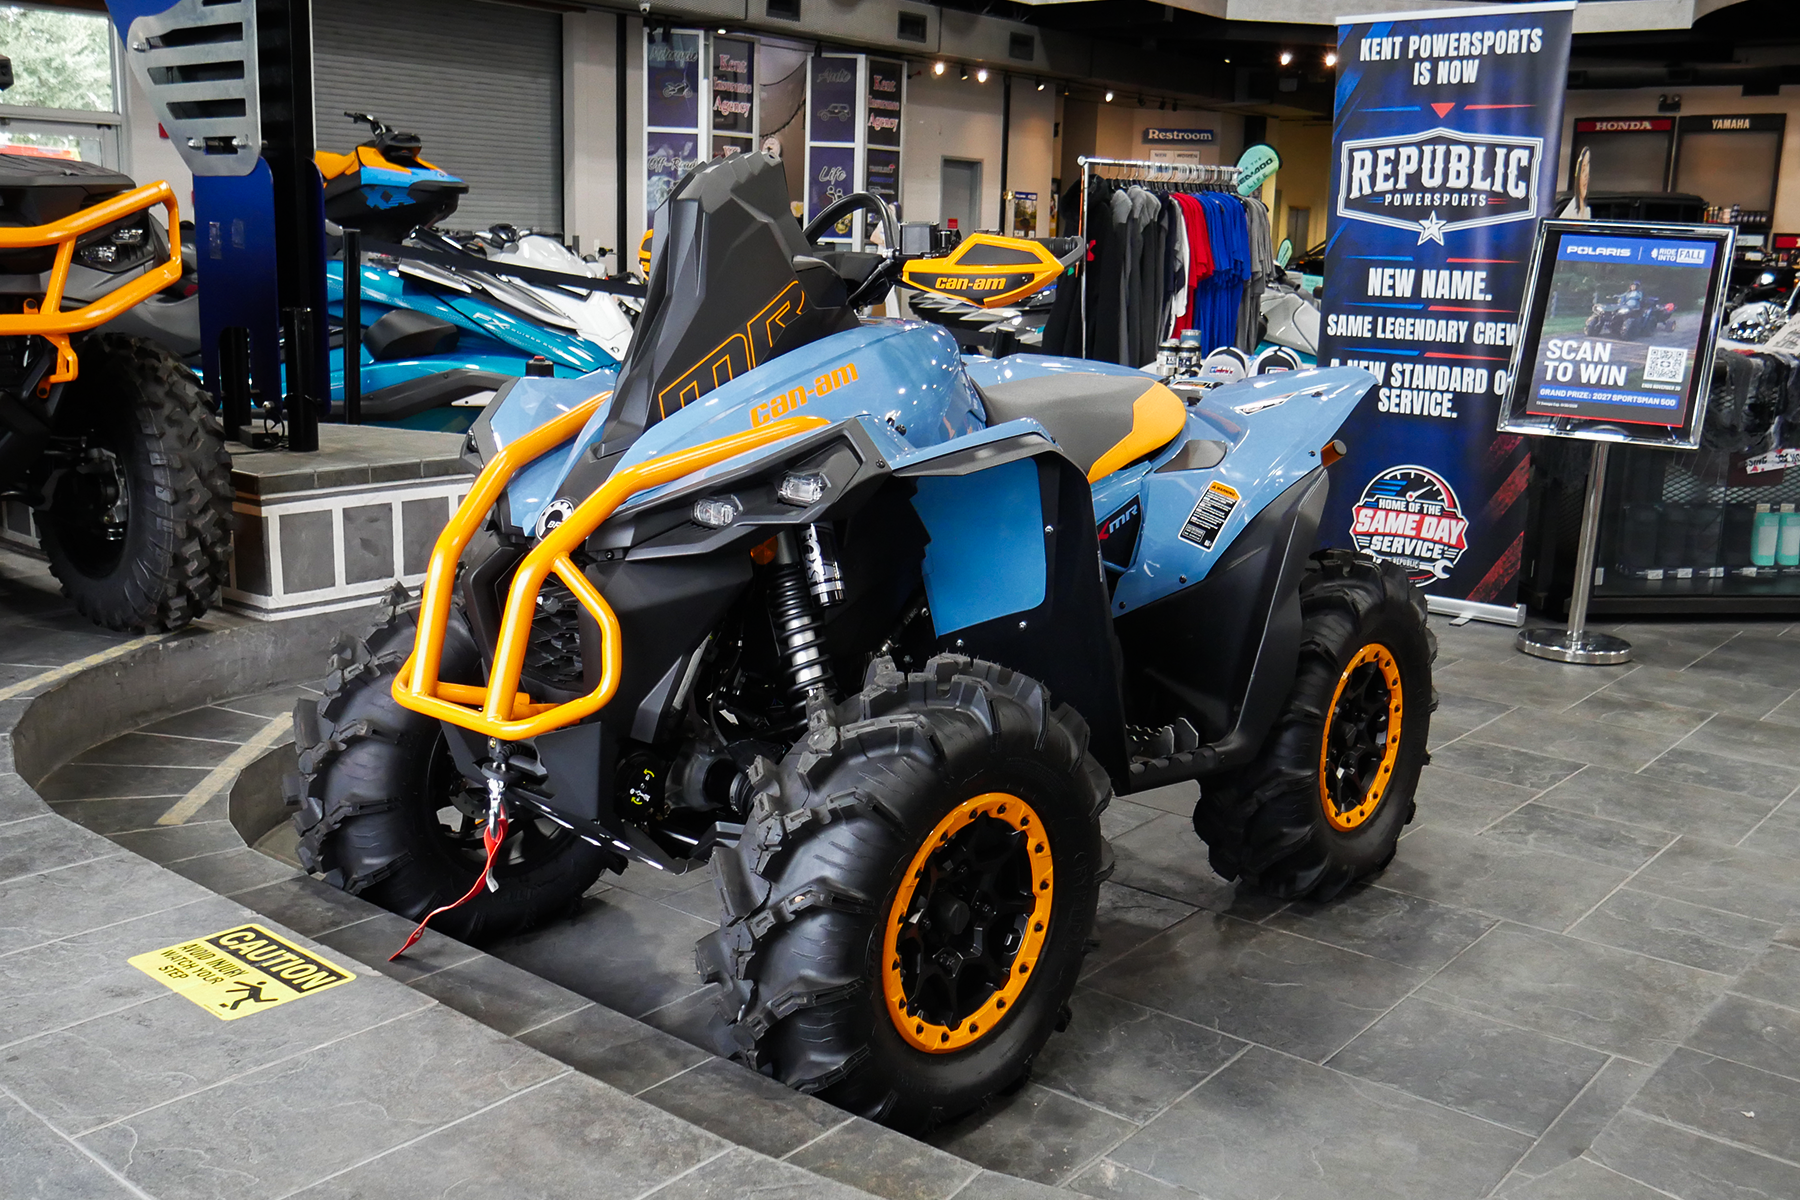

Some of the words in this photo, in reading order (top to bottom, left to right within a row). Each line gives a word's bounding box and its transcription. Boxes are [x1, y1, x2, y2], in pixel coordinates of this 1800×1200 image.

[1360, 36, 1403, 62] KENT
[1408, 28, 1543, 60] POWERSPORTS
[719, 54, 747, 73] Kent
[1413, 62, 1431, 85] IS
[1436, 59, 1480, 85] NOW
[873, 75, 896, 92] Kent
[713, 95, 751, 118] Agency
[867, 112, 899, 132] Agency
[1595, 121, 1652, 132] HONDA
[1712, 118, 1750, 130] YAMAHA
[1148, 129, 1212, 140] Restroom
[819, 165, 847, 185] Life
[1349, 145, 1530, 200] REPUBLIC
[1384, 193, 1487, 207] POWERSPORTS
[1567, 245, 1631, 257] POLARIS
[1659, 248, 1677, 256] RIDE
[1679, 250, 1703, 260] FALL
[935, 277, 1007, 290] can-am
[1367, 267, 1415, 298] NEW
[1420, 269, 1493, 302] NAME.
[472, 312, 511, 330] FX
[1327, 313, 1373, 338] SAME
[1376, 316, 1469, 343] LEGENDARY
[1546, 339, 1612, 363] SCAN
[1390, 362, 1488, 394] STANDARD
[1493, 370, 1507, 396] O
[1543, 360, 1574, 381] TO
[1580, 362, 1627, 387] WIN
[749, 362, 859, 429] can-am
[1377, 388, 1458, 419] SERVICE.
[1540, 388, 1566, 397] GRAND
[1567, 389, 1592, 400] PRIZE:
[1592, 392, 1611, 401] 2027
[1611, 393, 1659, 405] SPORTSMAN
[1660, 398, 1676, 407] 500
[1378, 499, 1406, 510] HOME
[1408, 502, 1421, 513] OF
[1422, 504, 1442, 515] THE
[1355, 508, 1419, 536] SAME
[1420, 516, 1465, 545] DAY
[160, 950, 196, 970] WATCH
[192, 966, 225, 985] YOUR
[178, 943, 217, 964] AVOID
[205, 956, 250, 979] INJURY
[219, 931, 337, 990] CAUTION
[157, 964, 190, 981] STEP
